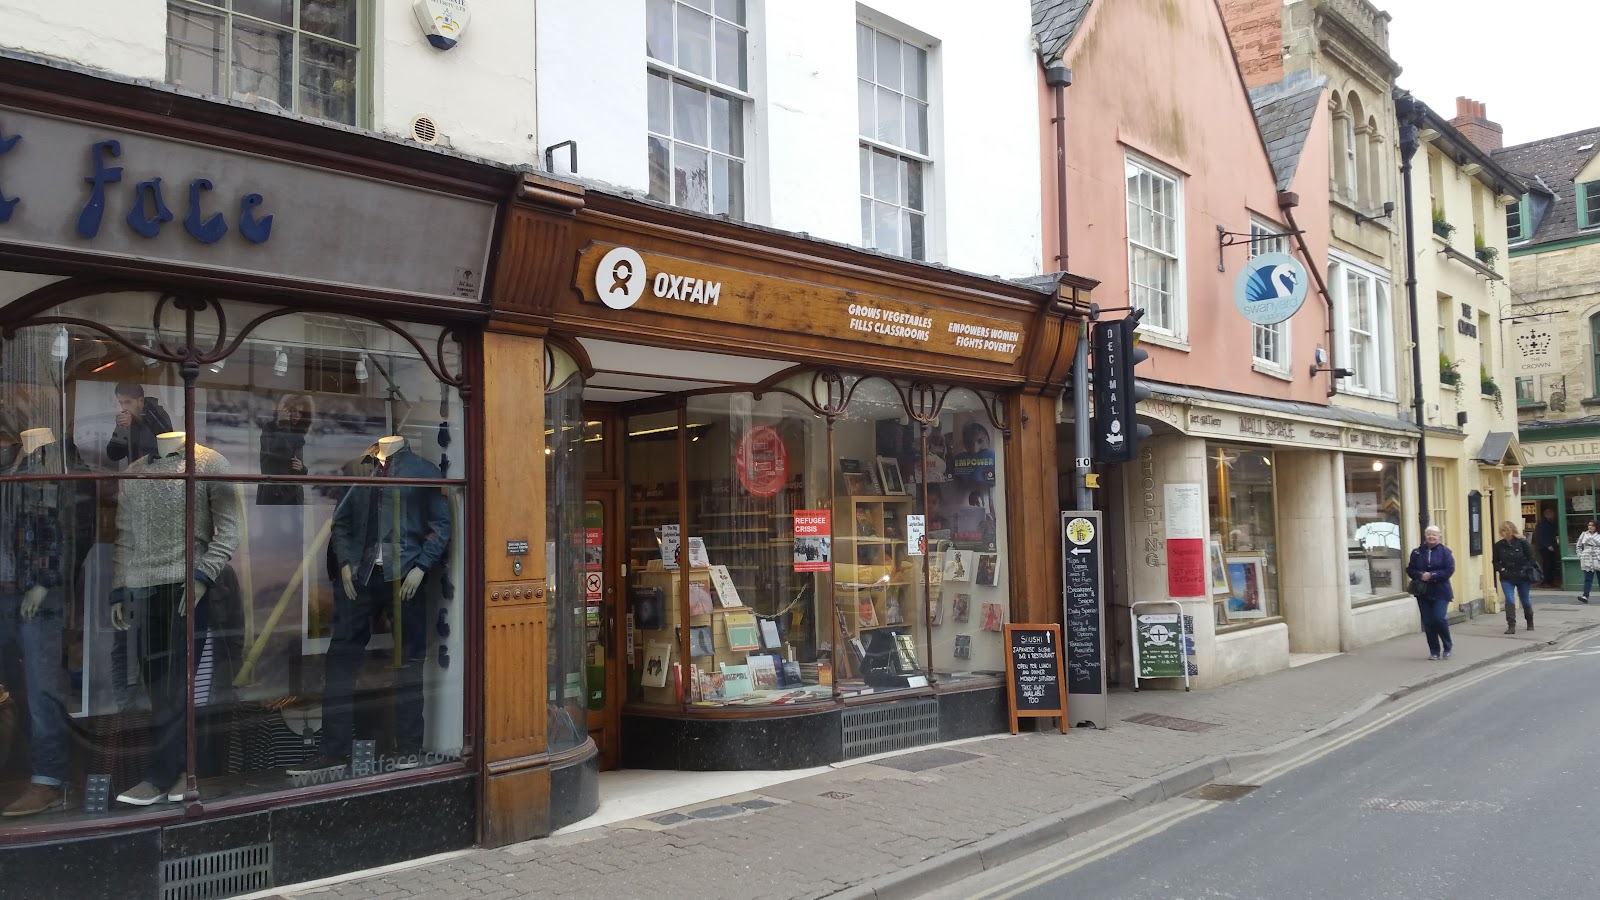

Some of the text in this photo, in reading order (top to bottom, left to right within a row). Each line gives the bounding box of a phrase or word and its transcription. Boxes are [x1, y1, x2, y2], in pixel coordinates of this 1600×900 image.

[76, 139, 273, 243] face
[653, 272, 721, 306] OXFAM
[1243, 296, 1299, 315] swanyard
[848, 303, 933, 329] GROWS VEGETABLES
[849, 318, 930, 342] FILLS CLASSROOMS
[947, 322, 1019, 342] EMPOWERS WOMEN
[955, 335, 1016, 353] FIGHTS POVERTY
[1107, 328, 1119, 415] DECIMAL
[1521, 361, 1551, 370] CROWN
[1545, 442, 1600, 458] GALLE
[955, 457, 994, 467] EMPOWER
[1076, 458, 1090, 467] 10
[795, 525, 817, 533] CRISIS
[291, 747, 461, 787] www.fatface.com
